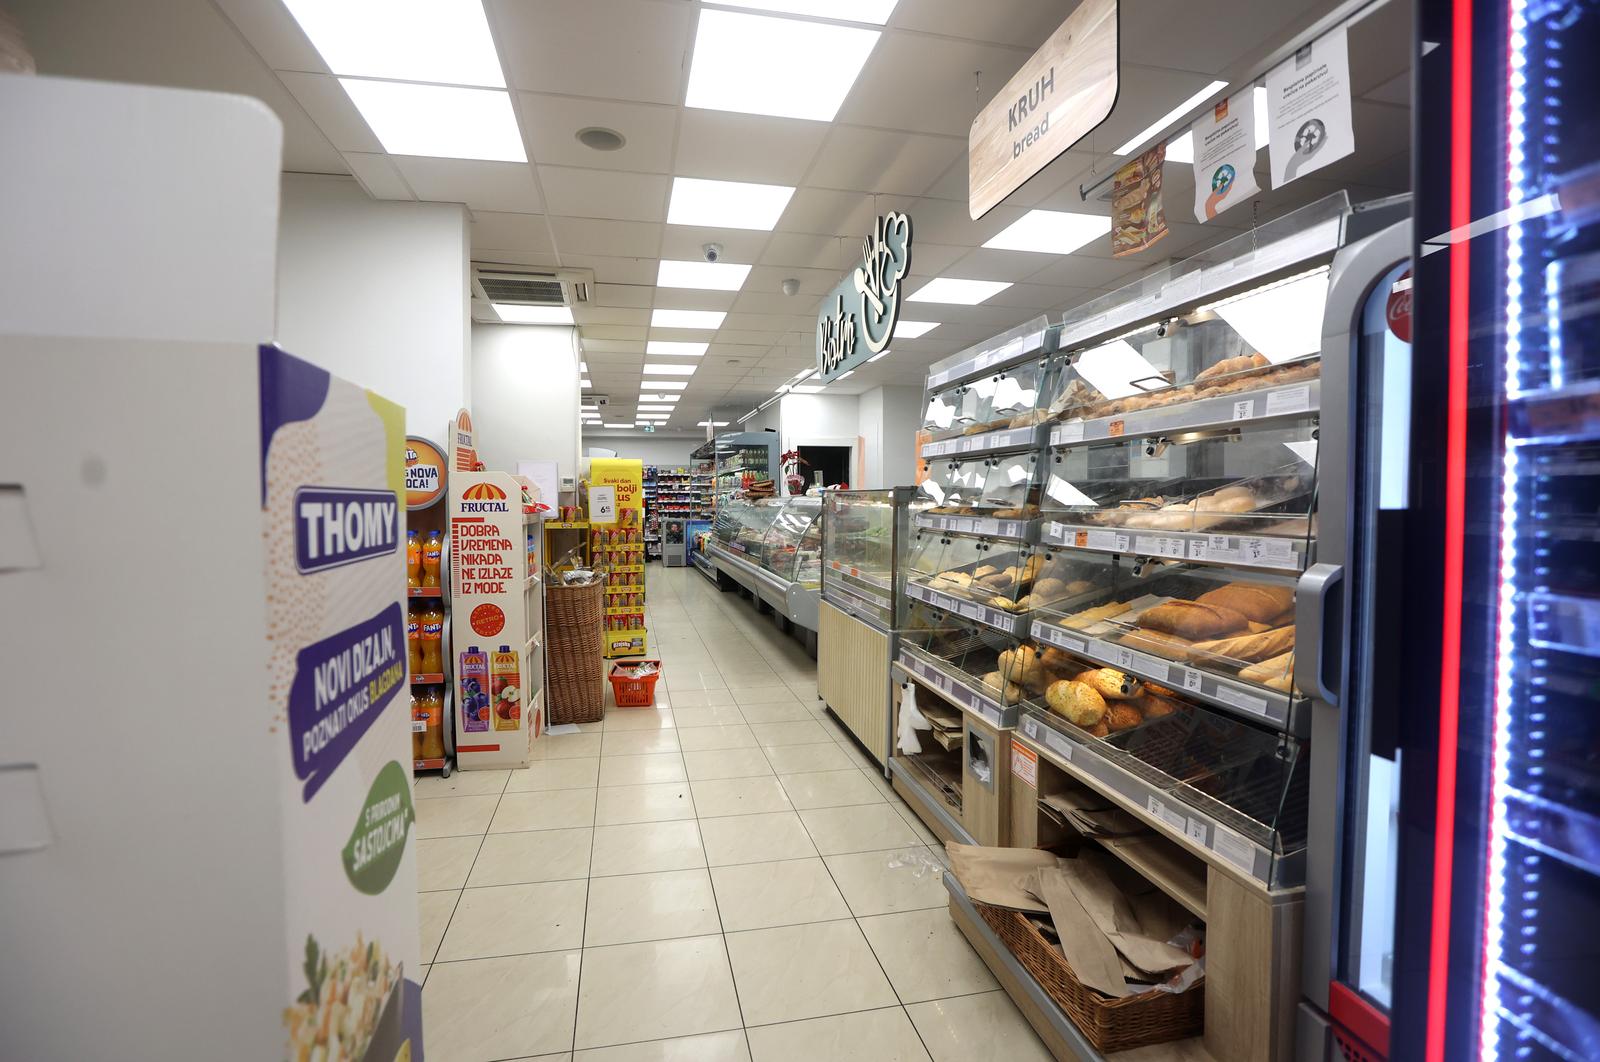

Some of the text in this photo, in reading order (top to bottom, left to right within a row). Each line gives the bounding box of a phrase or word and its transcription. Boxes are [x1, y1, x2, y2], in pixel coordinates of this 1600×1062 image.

[1008, 66, 1055, 133] KRUH
[1013, 111, 1049, 161] bread
[819, 294, 857, 375] Bistro
[410, 467, 438, 478] NOVA
[405, 479, 429, 489] OCA!
[616, 484, 638, 494] bolji
[617, 494, 631, 502] us
[460, 502, 509, 513] FRUCTAL
[300, 501, 395, 559] THOMY
[460, 524, 500, 537] DOBRA
[460, 539, 513, 551] VREMENA
[461, 553, 503, 566] NIKADA
[461, 567, 513, 580] NE IZLAZE
[462, 582, 507, 594] IZ MODE.
[476, 614, 500, 626] RETRO
[314, 648, 352, 712] NOVI
[303, 703, 348, 763] POZNATI
[347, 685, 370, 724] OKUS
